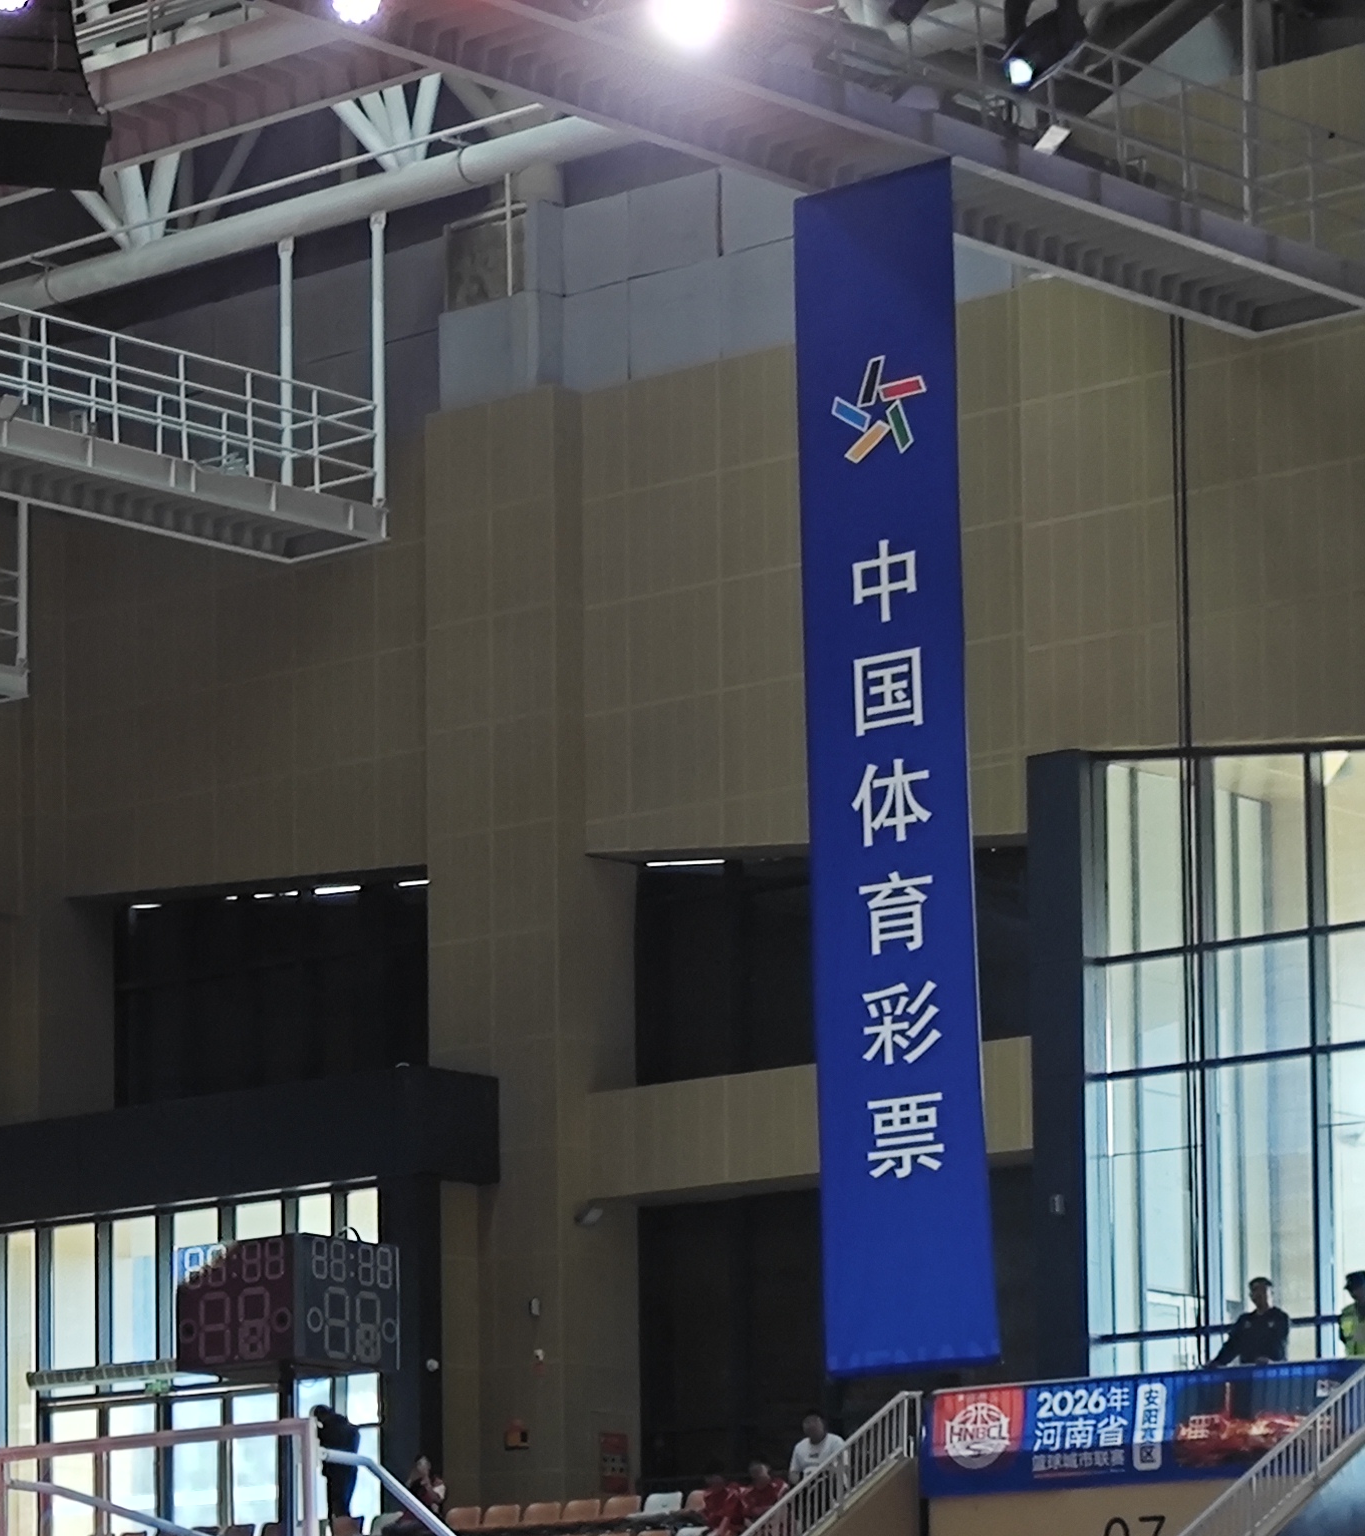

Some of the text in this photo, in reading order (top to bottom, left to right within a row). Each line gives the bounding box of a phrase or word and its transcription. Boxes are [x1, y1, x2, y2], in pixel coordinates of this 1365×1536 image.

[851, 540, 945, 1179] 中国体育彩票
[1036, 1387, 1130, 1418] 2026年
[1033, 1415, 1128, 1452] 河南省
